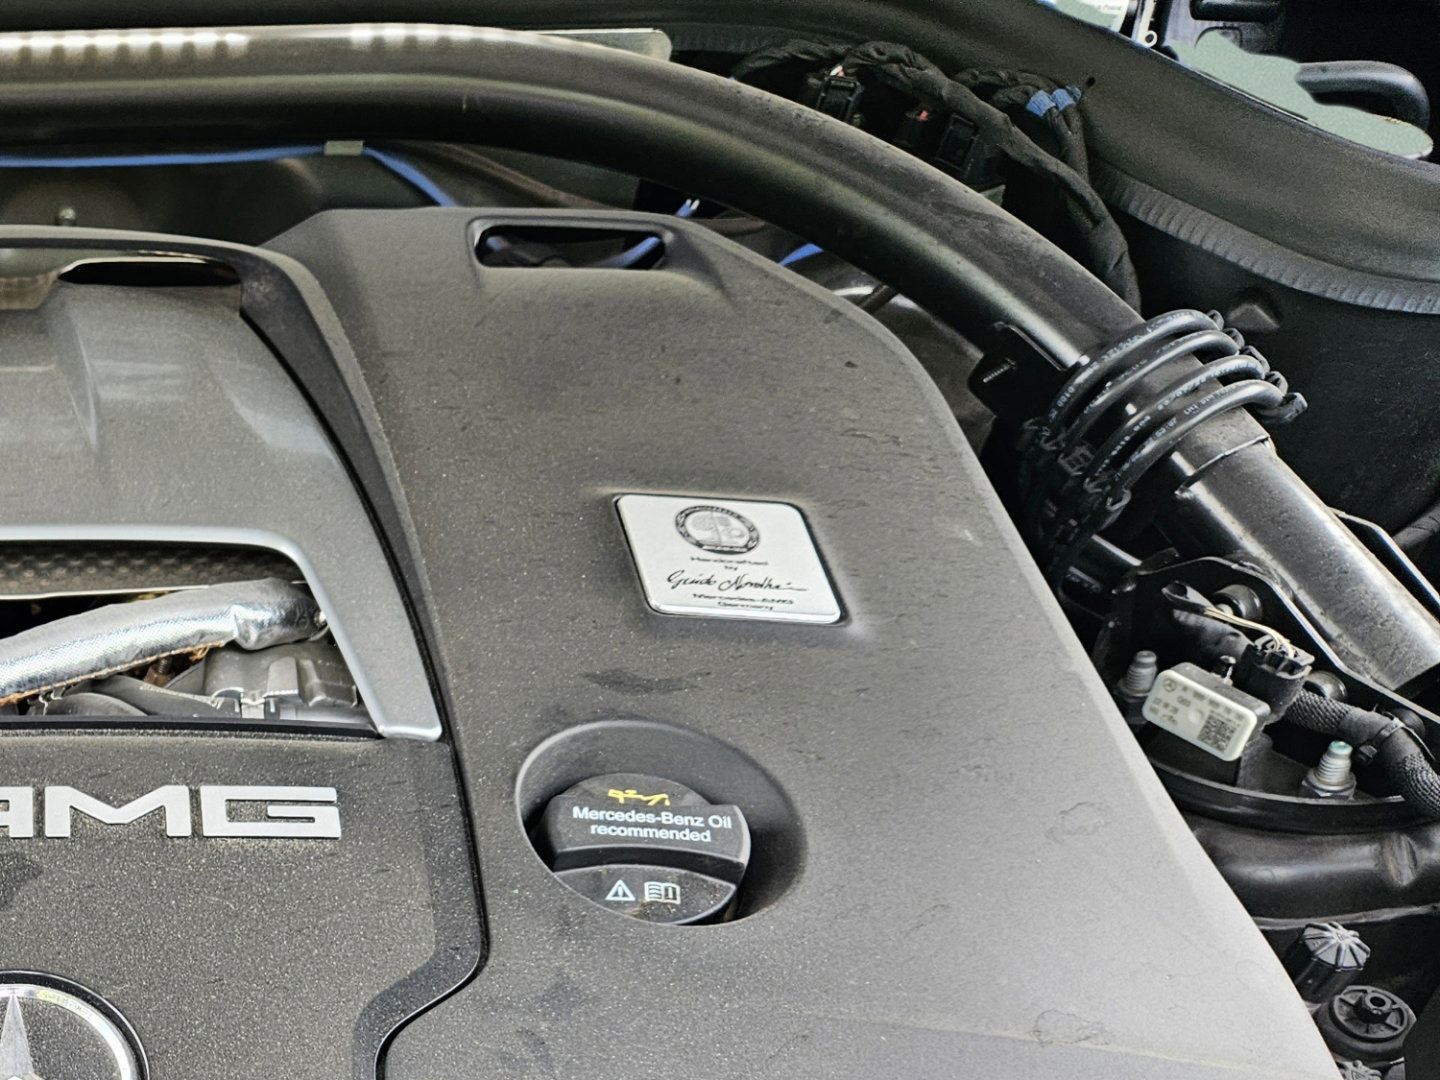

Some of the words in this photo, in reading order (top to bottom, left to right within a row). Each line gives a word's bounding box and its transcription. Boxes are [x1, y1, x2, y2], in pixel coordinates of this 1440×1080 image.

[572, 805, 705, 827] Mercedes-Benz
[708, 815, 732, 829] Oil
[590, 823, 711, 842] recommended
